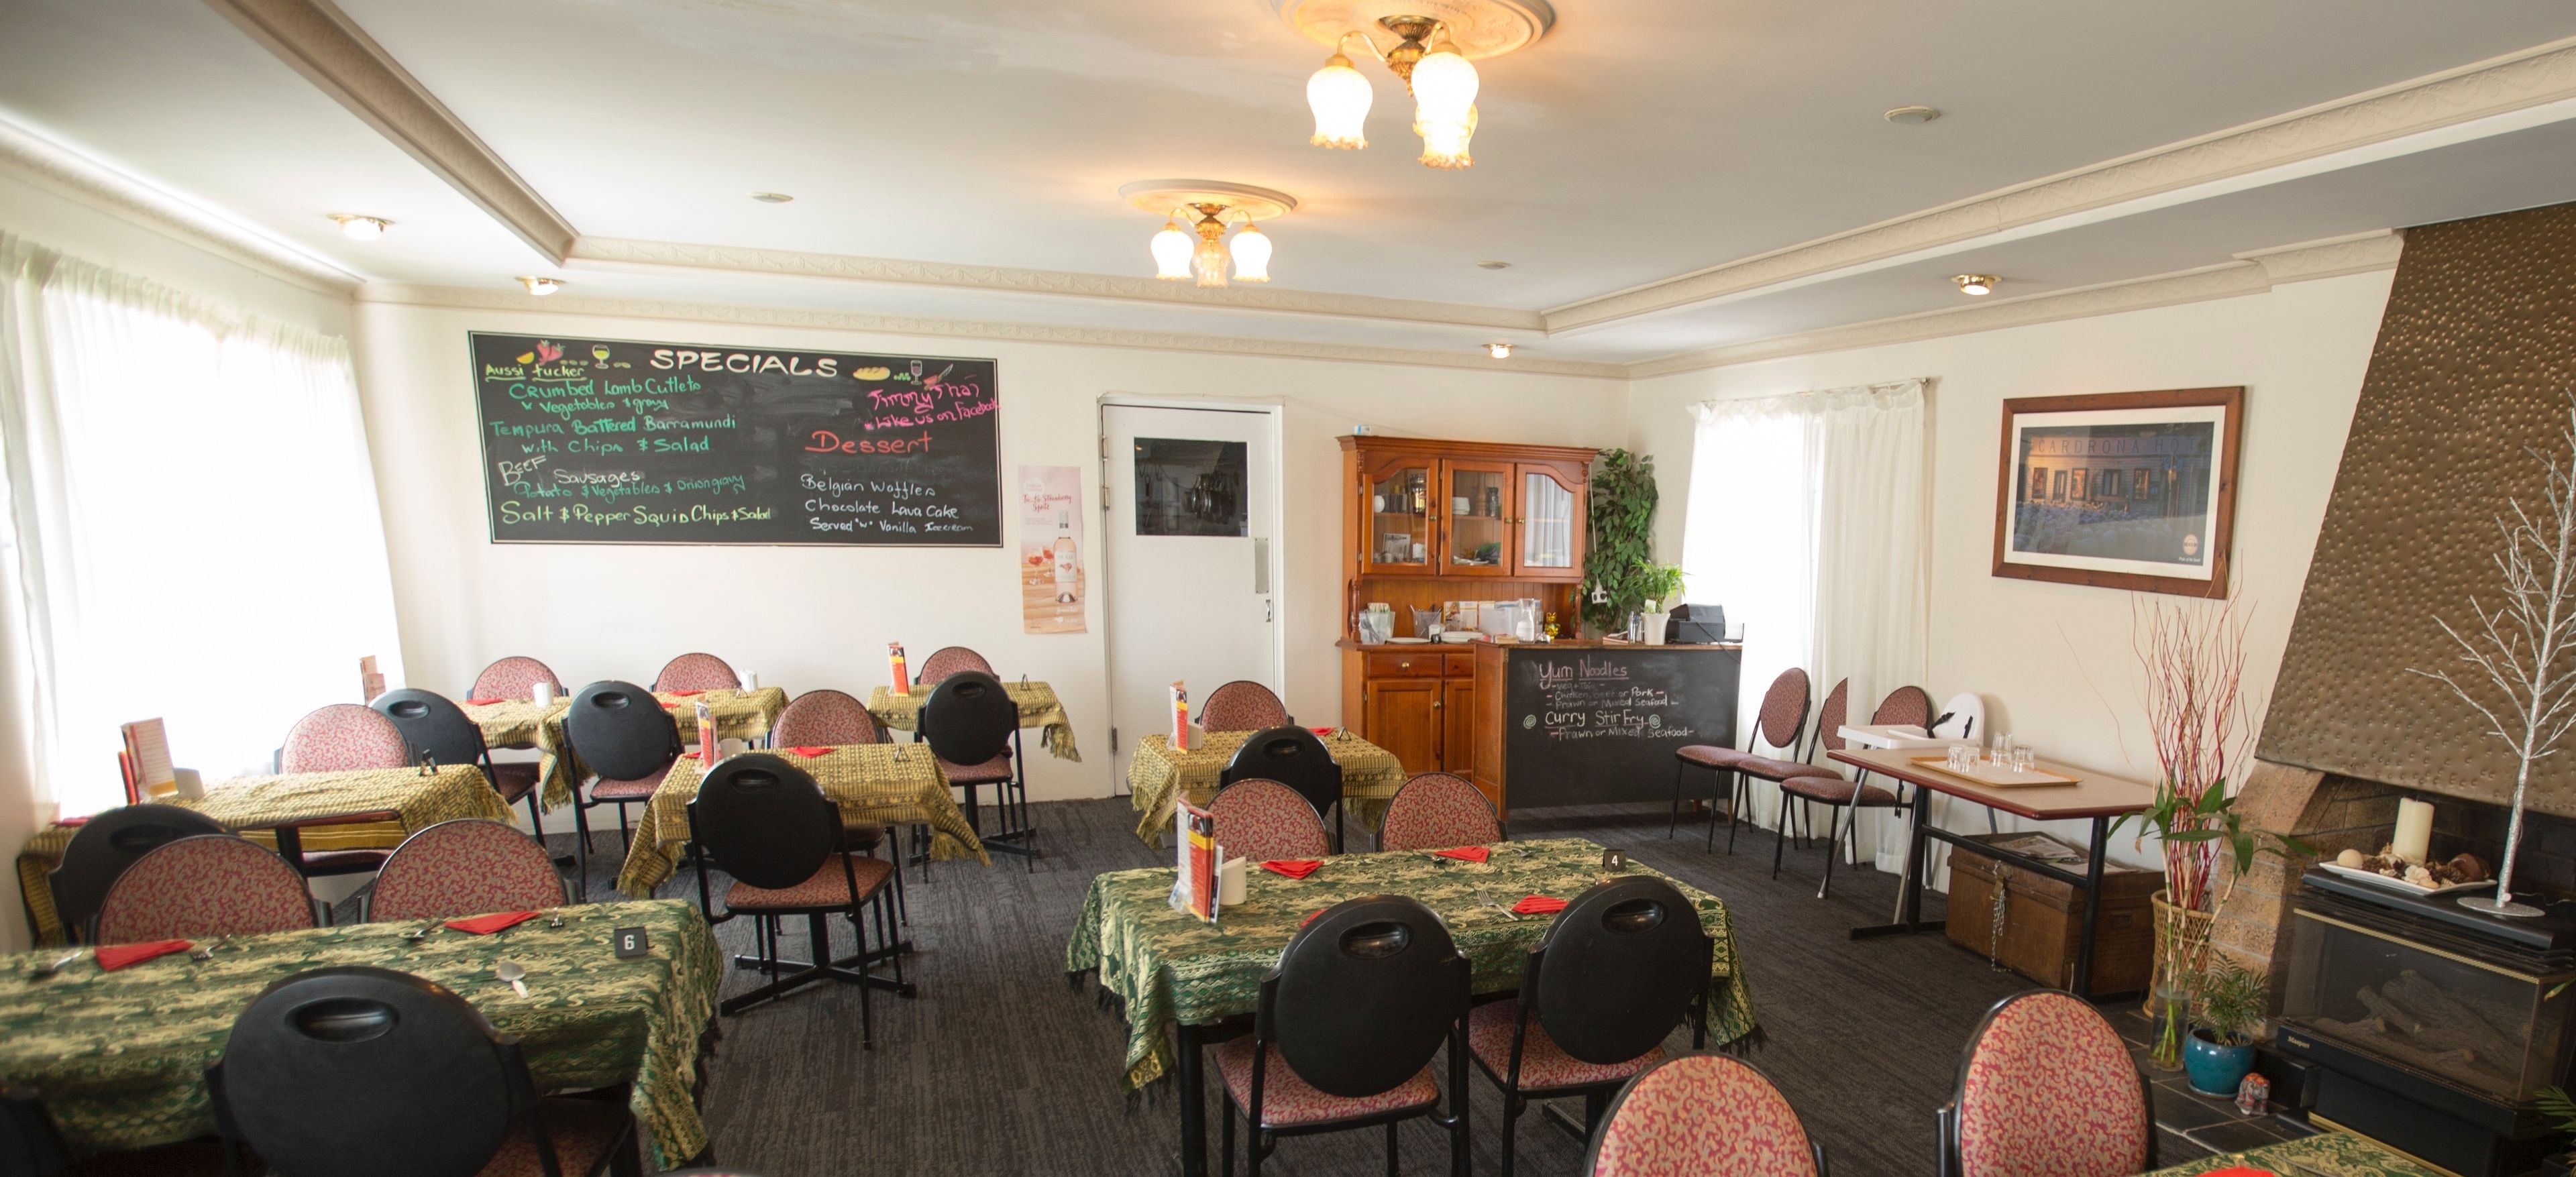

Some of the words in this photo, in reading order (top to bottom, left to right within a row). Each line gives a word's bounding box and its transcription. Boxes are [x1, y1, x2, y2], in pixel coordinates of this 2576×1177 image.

[485, 363, 525, 376] Aussi
[531, 363, 585, 378] tucker
[649, 349, 838, 378] SPECIALS
[604, 377, 643, 395] Lamb
[645, 374, 702, 394] Cutlets
[539, 397, 615, 421] Vegetables
[633, 398, 669, 415] gravy
[936, 410, 957, 421] on
[488, 421, 565, 439] Tempura
[571, 415, 637, 435] Battered
[643, 412, 737, 431] Barramundi
[568, 437, 623, 457] Chips
[653, 435, 710, 453] Salad
[804, 429, 932, 454] Dessert
[2038, 439, 2140, 455] CARDRONA
[591, 482, 661, 504] Vegetables
[800, 473, 864, 498] Belgian
[871, 480, 936, 500] Waffles
[500, 500, 554, 524] Salt
[572, 503, 631, 526] Pepper
[690, 504, 730, 526] Chips
[738, 506, 771, 520] Salad
[804, 497, 881, 514] Chocolate
[892, 500, 923, 517] Lava
[926, 504, 960, 519] Cake
[809, 516, 853, 533] Served
[879, 519, 917, 534] Vanilla
[1539, 661, 1573, 690] Yum
[1579, 654, 1627, 678] Noodles
[1631, 686, 1654, 697] Pork
[1635, 693, 1668, 707] Seafood
[1595, 710, 1621, 726] Stir
[1623, 708, 1644, 729] Fry
[1558, 726, 1593, 742] Prawn
[1611, 854, 1619, 866] 4
[624, 934, 635, 950] 6
